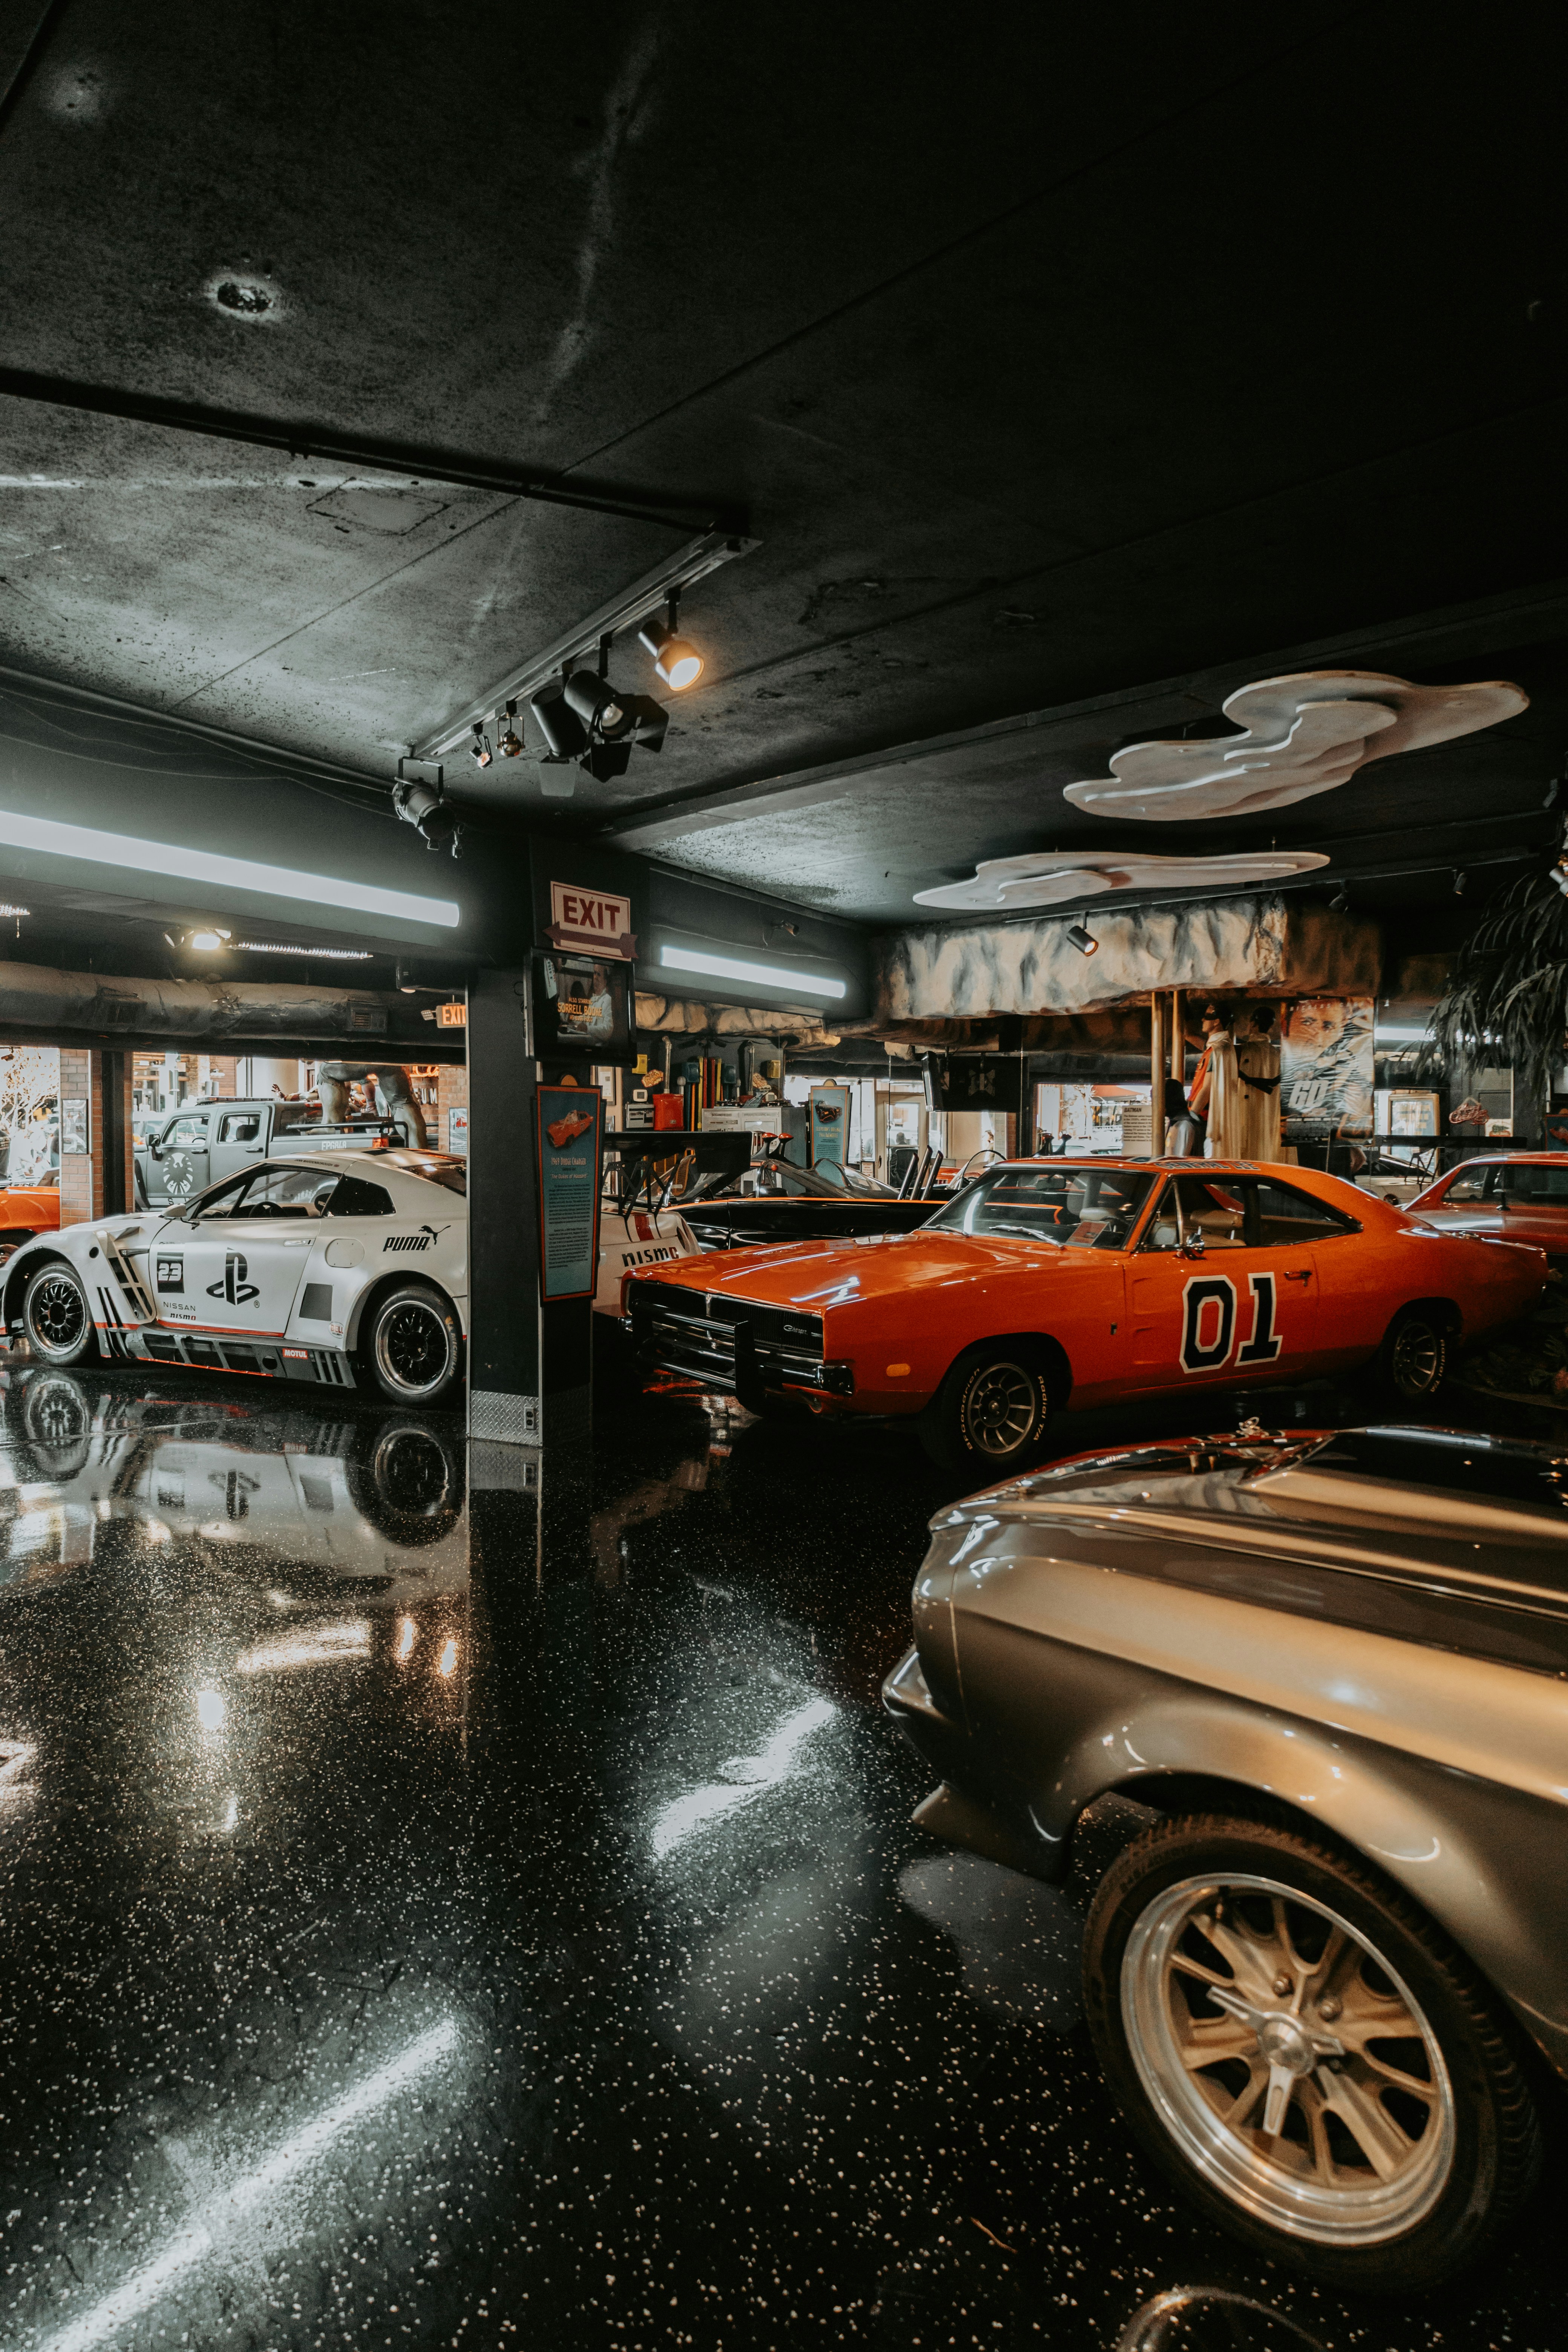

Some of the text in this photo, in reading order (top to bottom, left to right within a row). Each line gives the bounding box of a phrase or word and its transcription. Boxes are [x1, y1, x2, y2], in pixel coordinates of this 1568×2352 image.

[563, 894, 620, 932] EXIT
[442, 1006, 466, 1024] EXIT
[557, 1002, 603, 1017] SORRELL BOOKE
[1288, 1080, 1329, 1108] 60
[1227, 1162, 1261, 1170] LEE
[383, 1237, 430, 1252] PUMA
[622, 1247, 679, 1267] nismo
[158, 1263, 182, 1281] 23
[163, 1302, 196, 1311] NISSAN
[331, 1324, 343, 1334] BELL
[784, 1325, 808, 1335] Charger
[1179, 1272, 1283, 1374] 01
[285, 1349, 307, 1358] MOTUL
[449, 1333, 458, 1377] MICHELIN
[961, 1368, 1047, 1450] BFGoodrich Radial T/A
